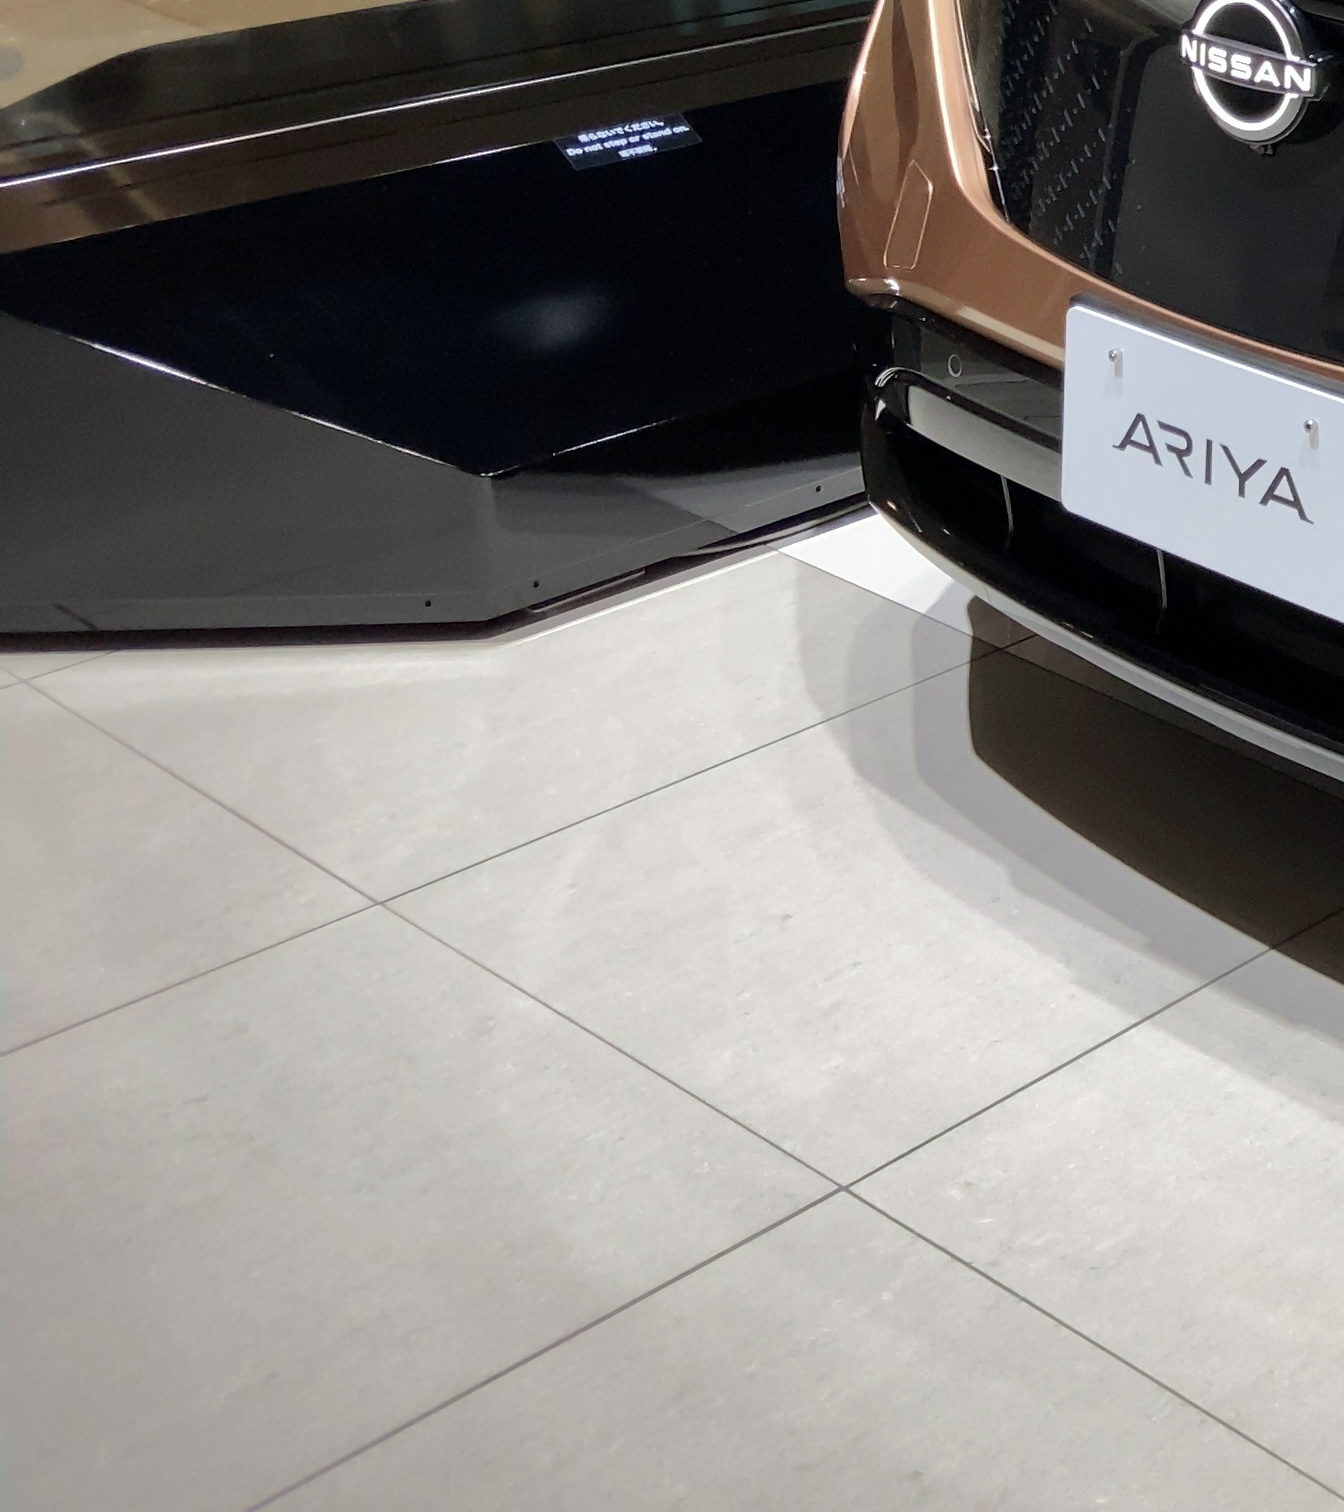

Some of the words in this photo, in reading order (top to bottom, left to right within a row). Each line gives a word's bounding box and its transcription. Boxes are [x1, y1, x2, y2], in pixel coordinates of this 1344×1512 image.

[1180, 34, 1312, 92] NISSAN
[566, 148, 583, 156] Do
[584, 143, 603, 152] not
[603, 138, 628, 148] step
[628, 135, 640, 143] or
[642, 128, 672, 140] stand
[1112, 412, 1315, 525] ARIYA
